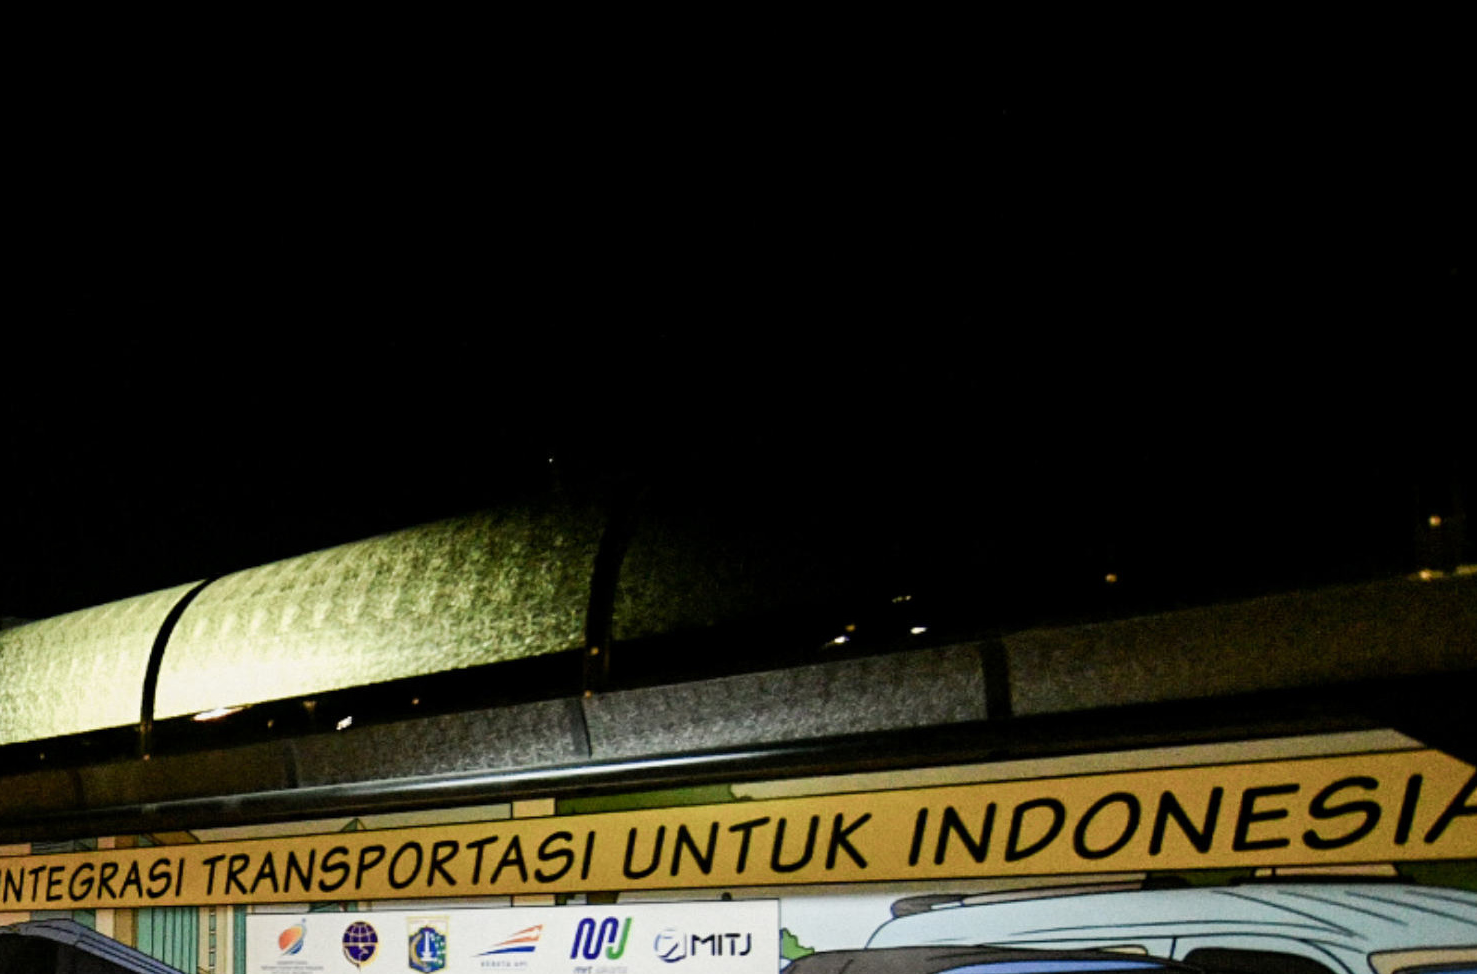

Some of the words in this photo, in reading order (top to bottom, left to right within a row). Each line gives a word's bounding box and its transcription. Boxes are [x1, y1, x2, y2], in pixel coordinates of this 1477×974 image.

[202, 830, 596, 895] TRANSPORTASI
[622, 812, 872, 880] UNTUK
[908, 764, 1477, 867] INDONESIA
[691, 932, 752, 957] MITJ
